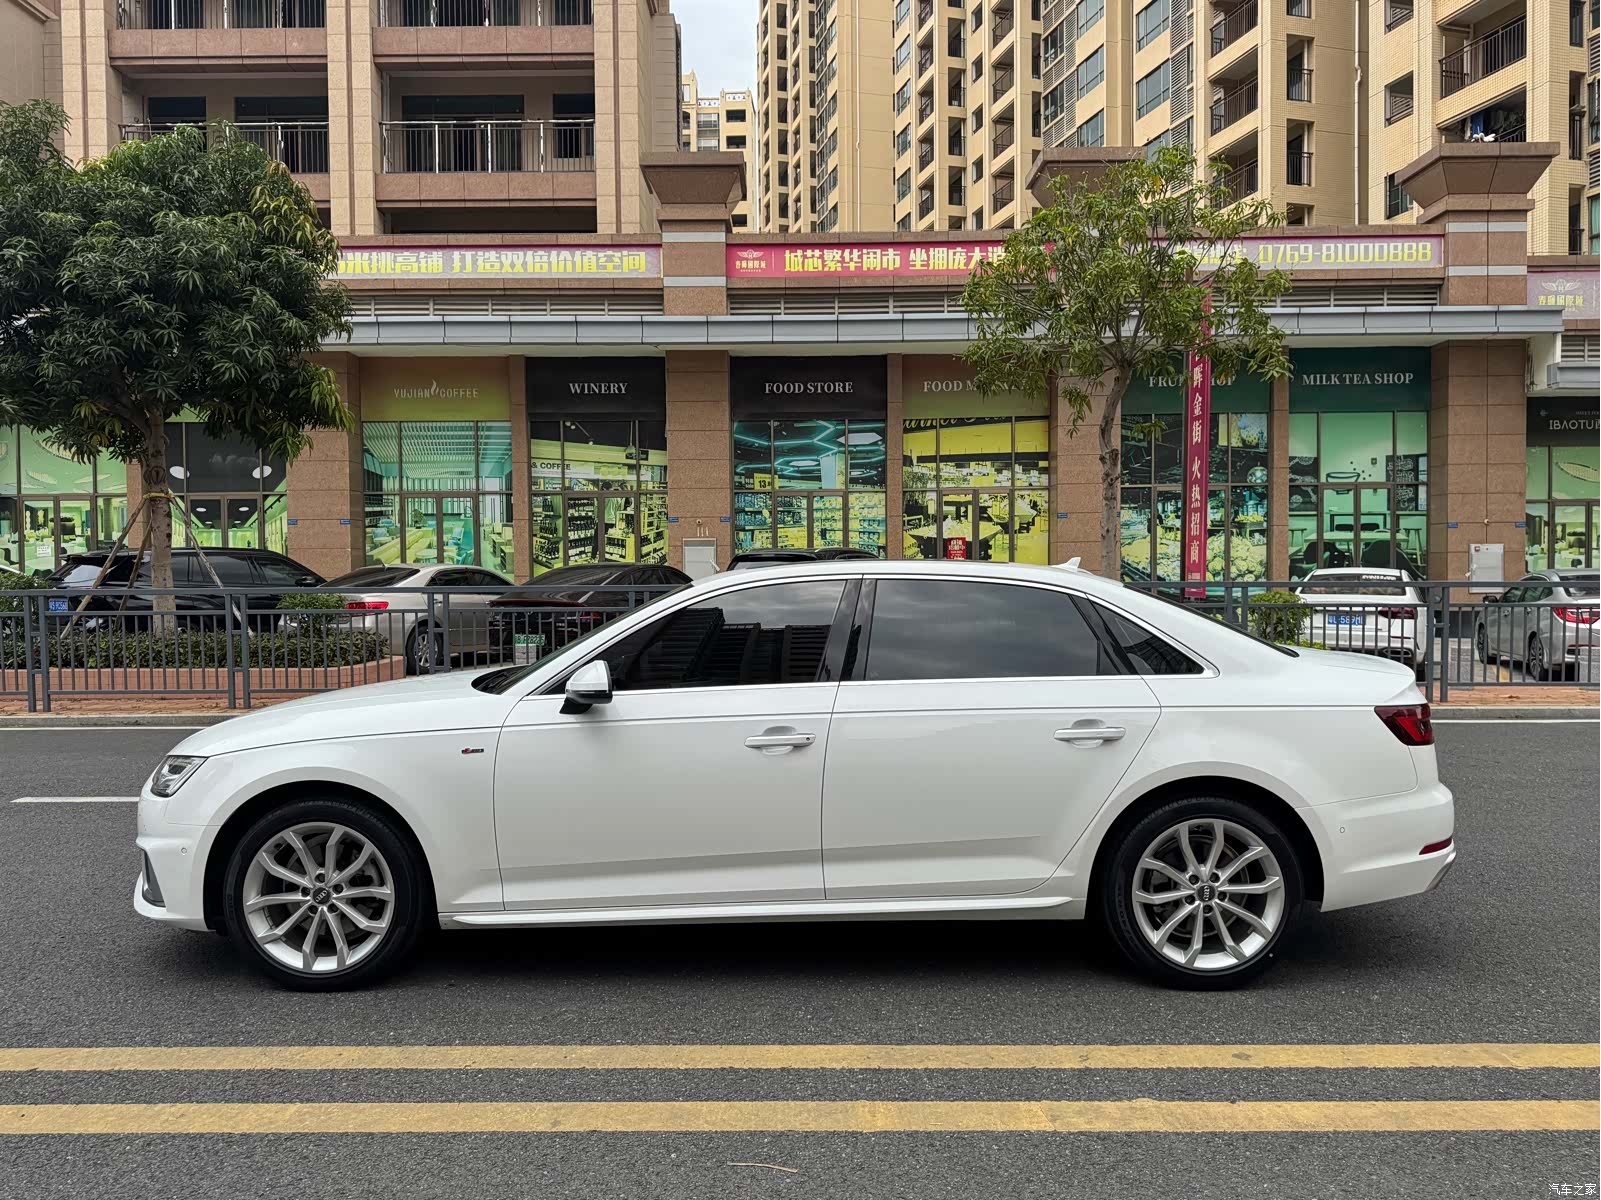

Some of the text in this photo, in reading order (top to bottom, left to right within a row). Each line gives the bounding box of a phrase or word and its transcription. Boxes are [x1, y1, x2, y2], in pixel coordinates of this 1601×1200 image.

[784, 248, 901, 272] 城芯繁华闹市
[1258, 242, 1432, 265] 0769-81000888
[452, 251, 647, 274] 打造双倍价值空间
[1302, 372, 1414, 385] MILK TEA SHOP
[568, 382, 628, 394] WINERY
[764, 381, 853, 394] FOOD STORE
[923, 380, 963, 392] FOOD
[393, 388, 479, 399] YUJIAN COFFEE
[1190, 456, 1201, 565] 火热招商
